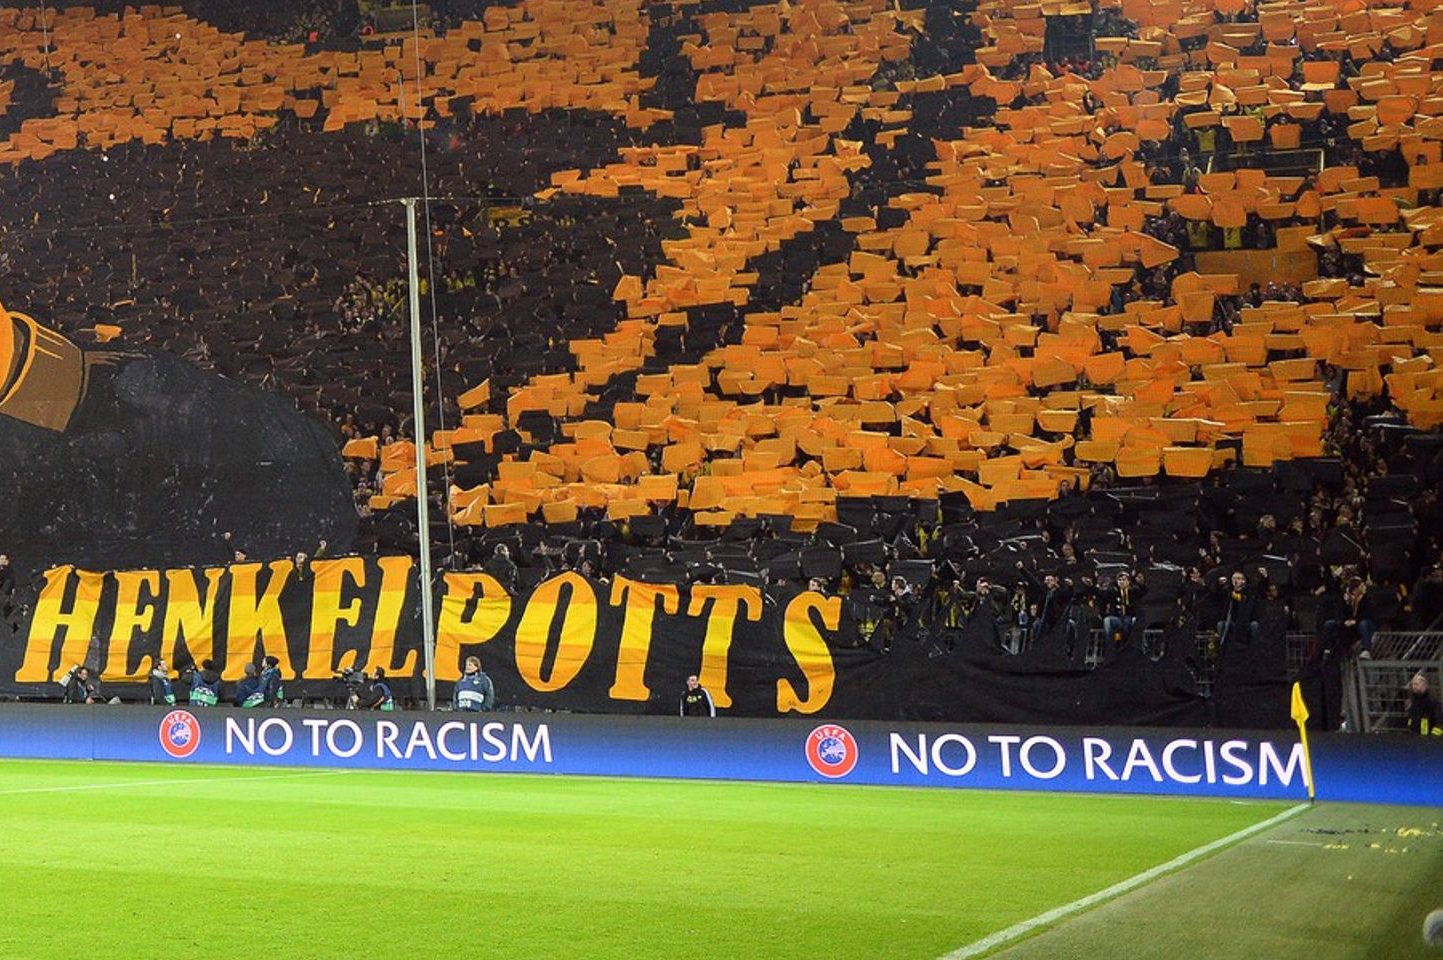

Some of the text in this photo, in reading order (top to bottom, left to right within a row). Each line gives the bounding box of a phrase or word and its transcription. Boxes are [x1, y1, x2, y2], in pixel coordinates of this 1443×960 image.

[225, 717, 553, 763] NO TO RACISM
[889, 732, 1310, 788] NO TO RACISM
